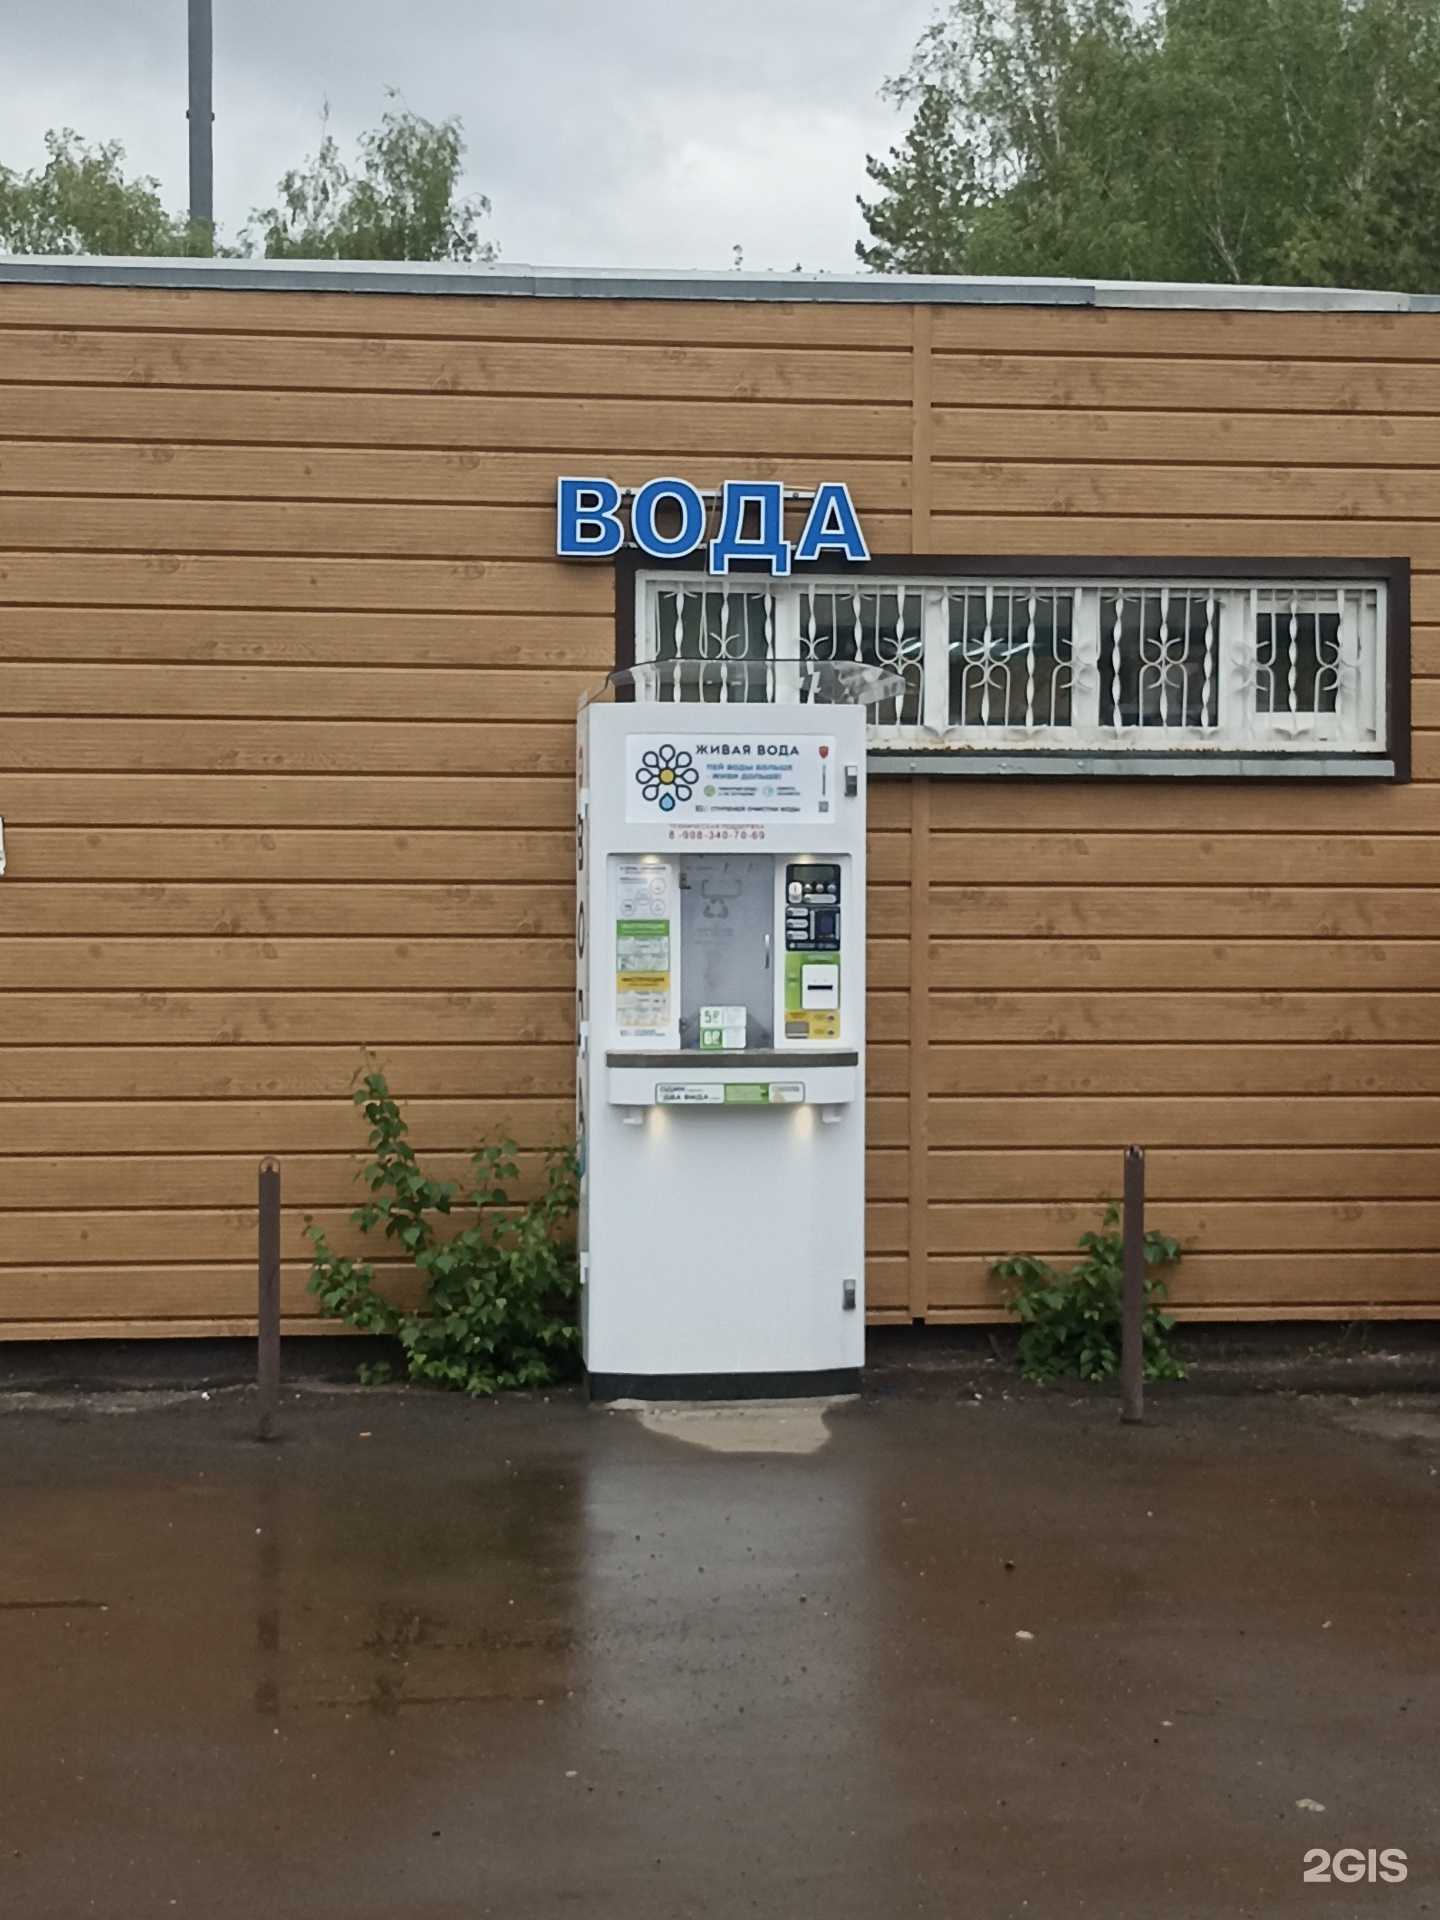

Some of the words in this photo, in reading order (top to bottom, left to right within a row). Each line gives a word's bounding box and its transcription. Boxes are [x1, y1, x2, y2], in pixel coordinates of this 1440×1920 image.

[557, 476, 871, 576] ВОДА
[696, 744, 751, 756] ЖИВАЯ
[757, 744, 799, 757] ВОДА
